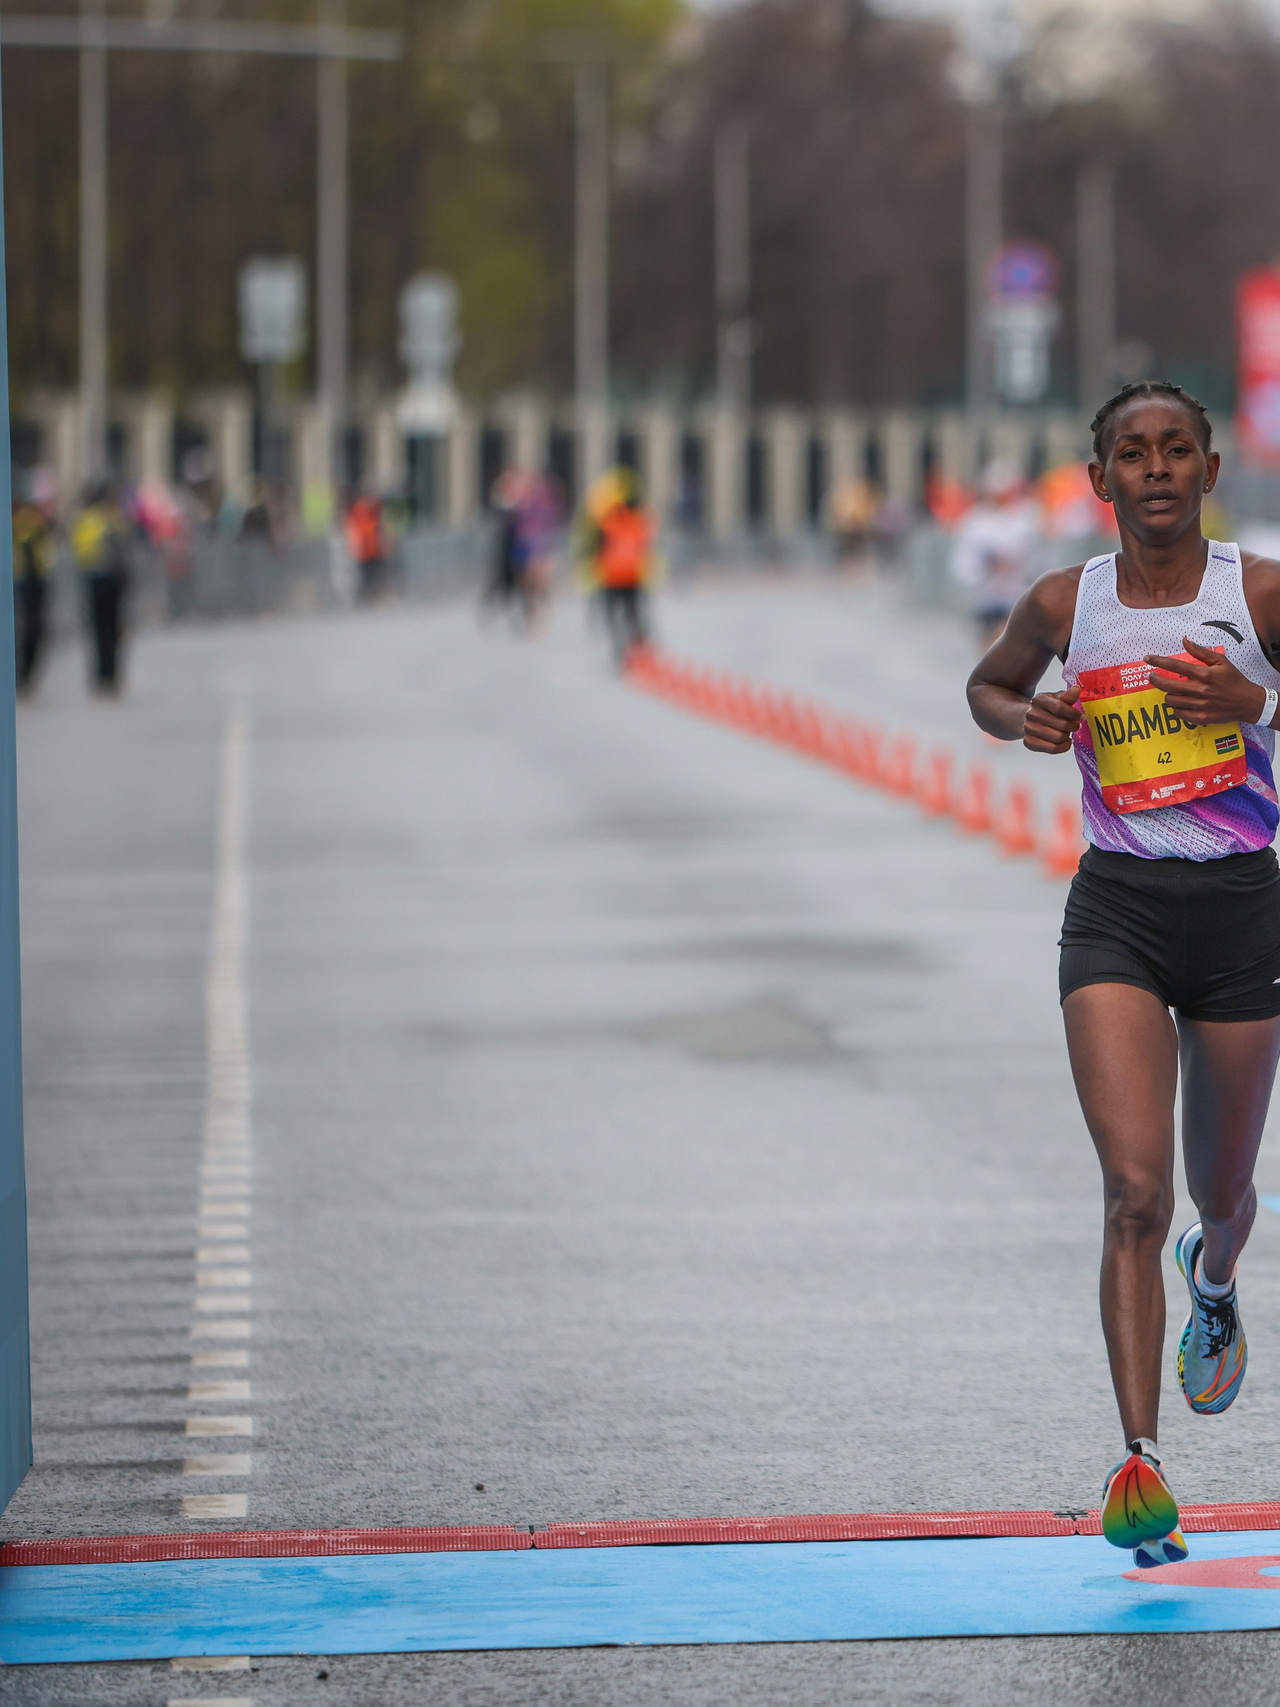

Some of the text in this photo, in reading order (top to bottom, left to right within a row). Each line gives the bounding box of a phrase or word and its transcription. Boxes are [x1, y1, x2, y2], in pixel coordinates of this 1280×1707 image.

[1120, 664, 1159, 676] МОСКОВ
[1122, 673, 1142, 683] ПОЛУ
[1094, 702, 1208, 748] NDAMB
[1157, 751, 1173, 765] 42
